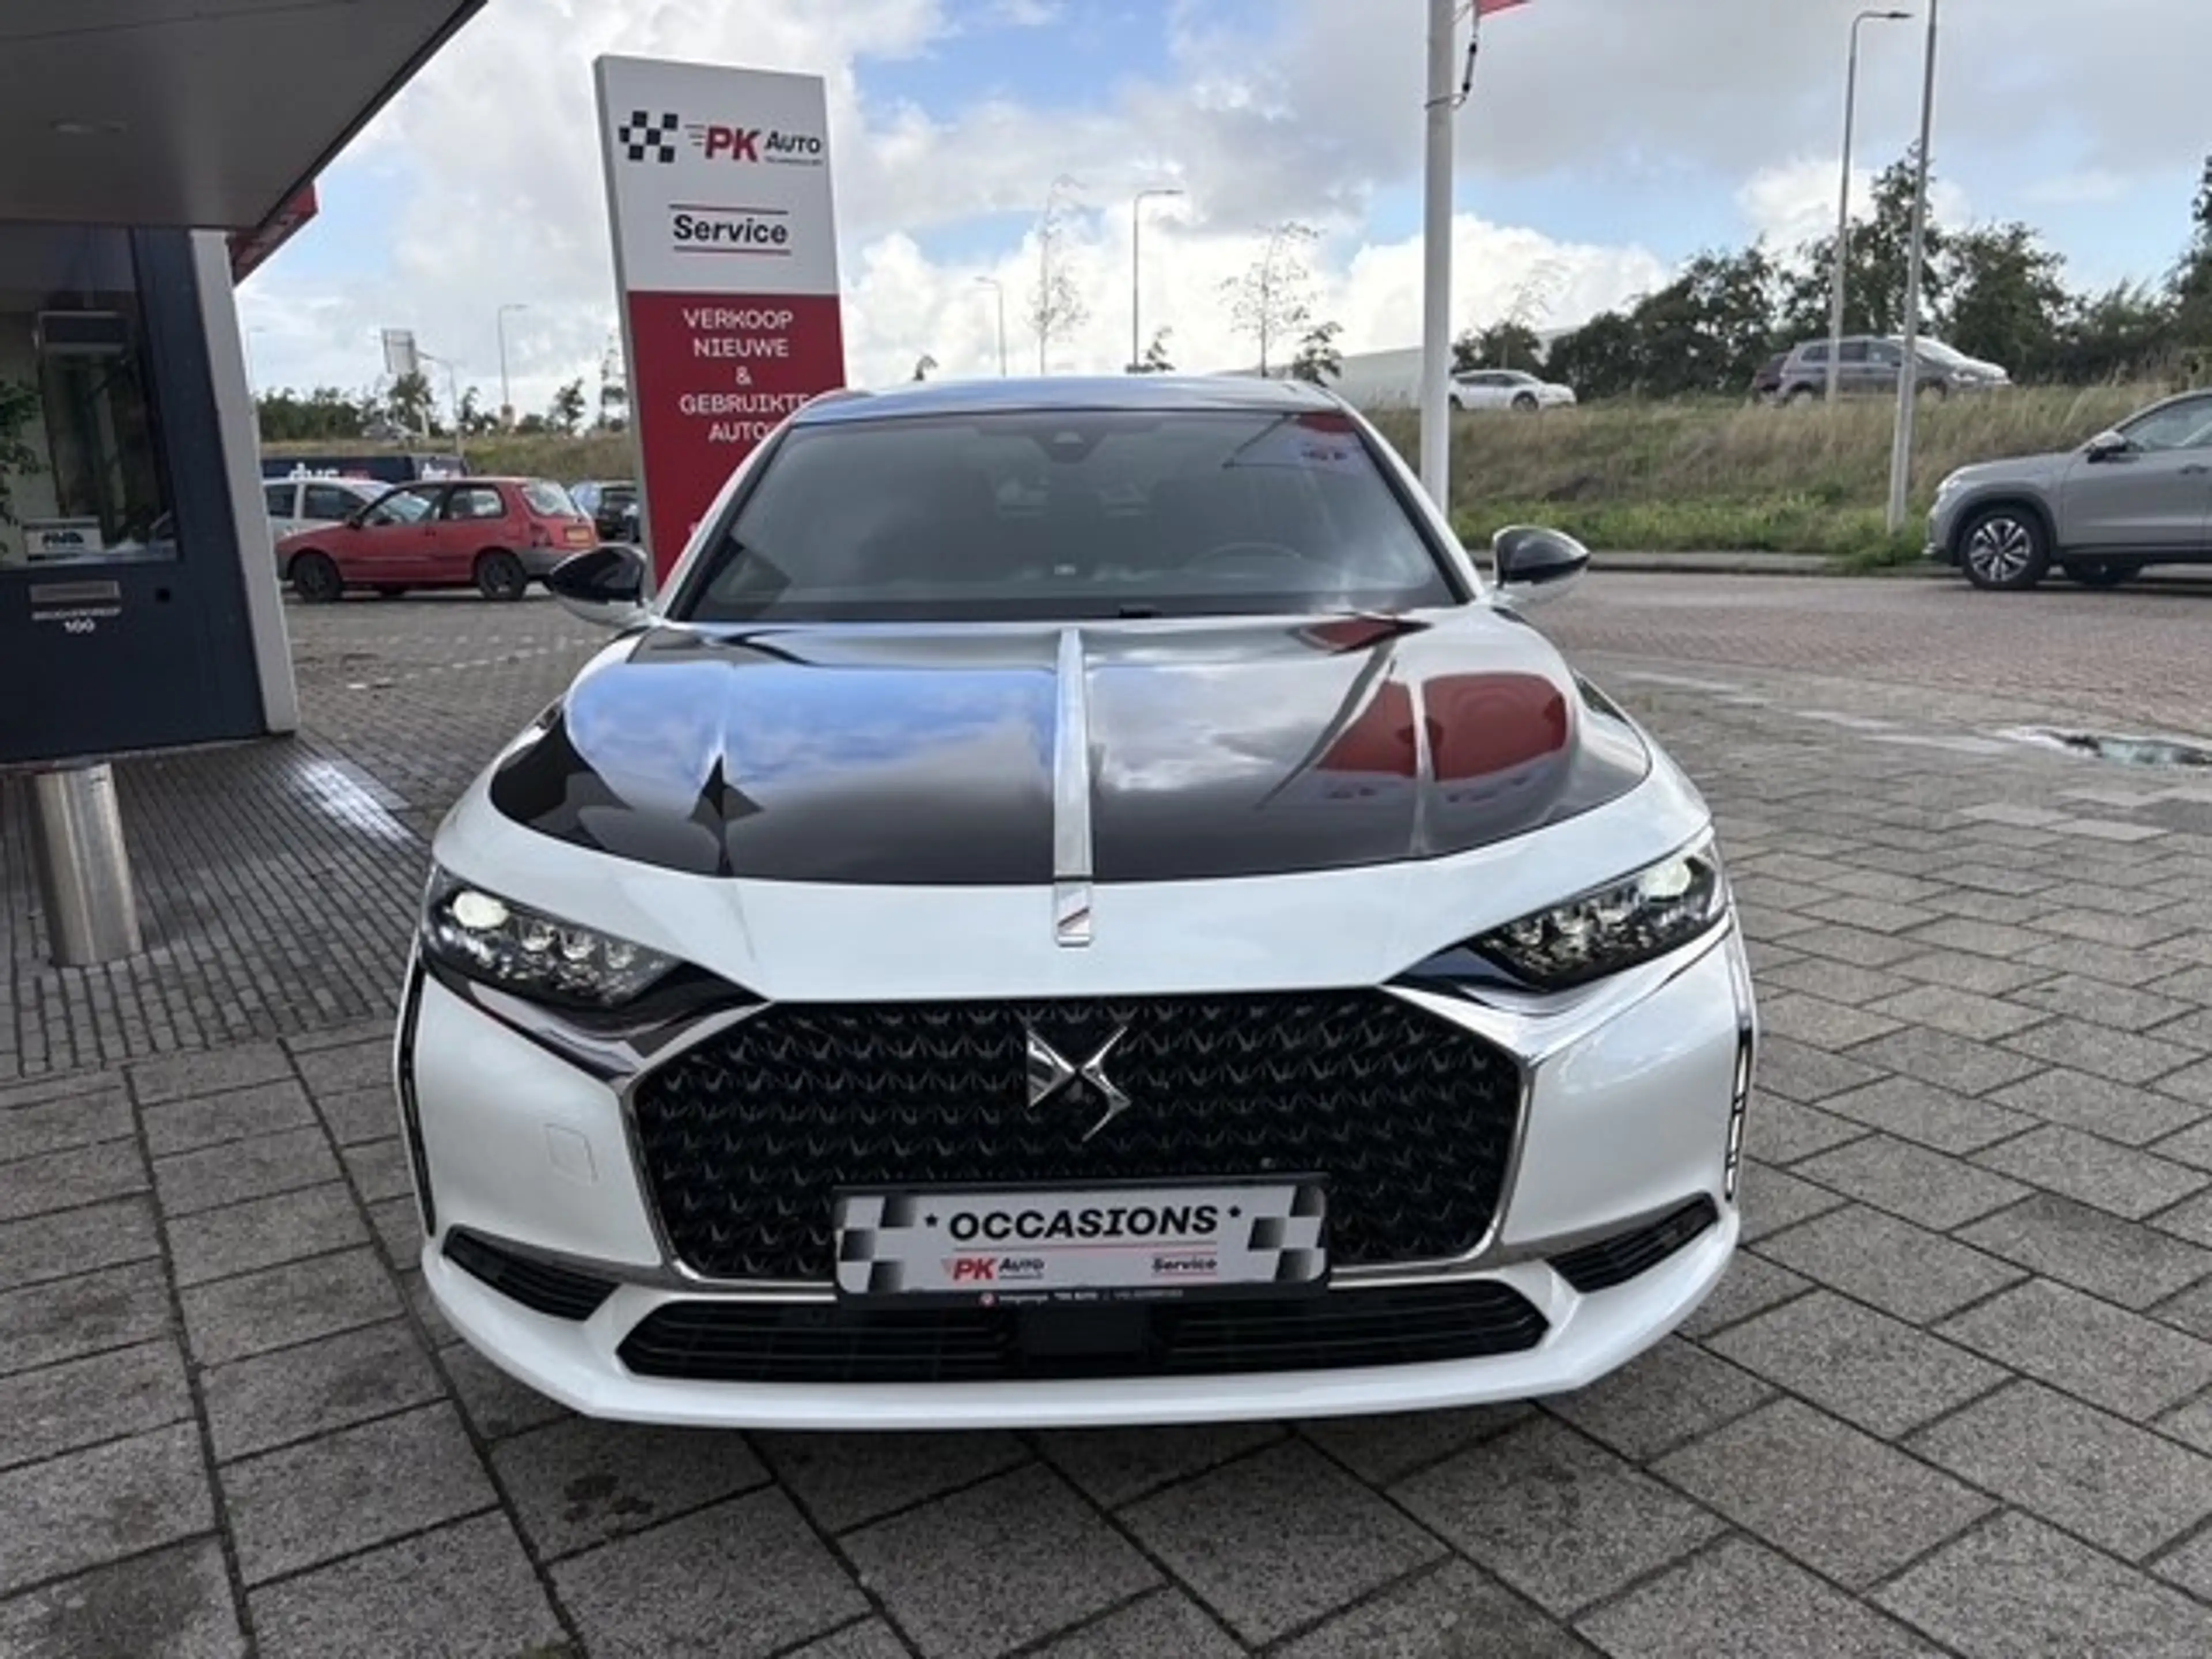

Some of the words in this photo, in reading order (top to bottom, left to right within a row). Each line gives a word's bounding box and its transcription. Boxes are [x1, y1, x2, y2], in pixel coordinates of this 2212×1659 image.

[705, 125, 762, 162] PK
[673, 214, 789, 244] Service
[682, 308, 794, 329] VERKOOP
[694, 338, 789, 358] NIEUWE
[735, 366, 752, 385] &
[948, 1205, 1219, 1241] OCCASIONS
[953, 1257, 998, 1281] PK
